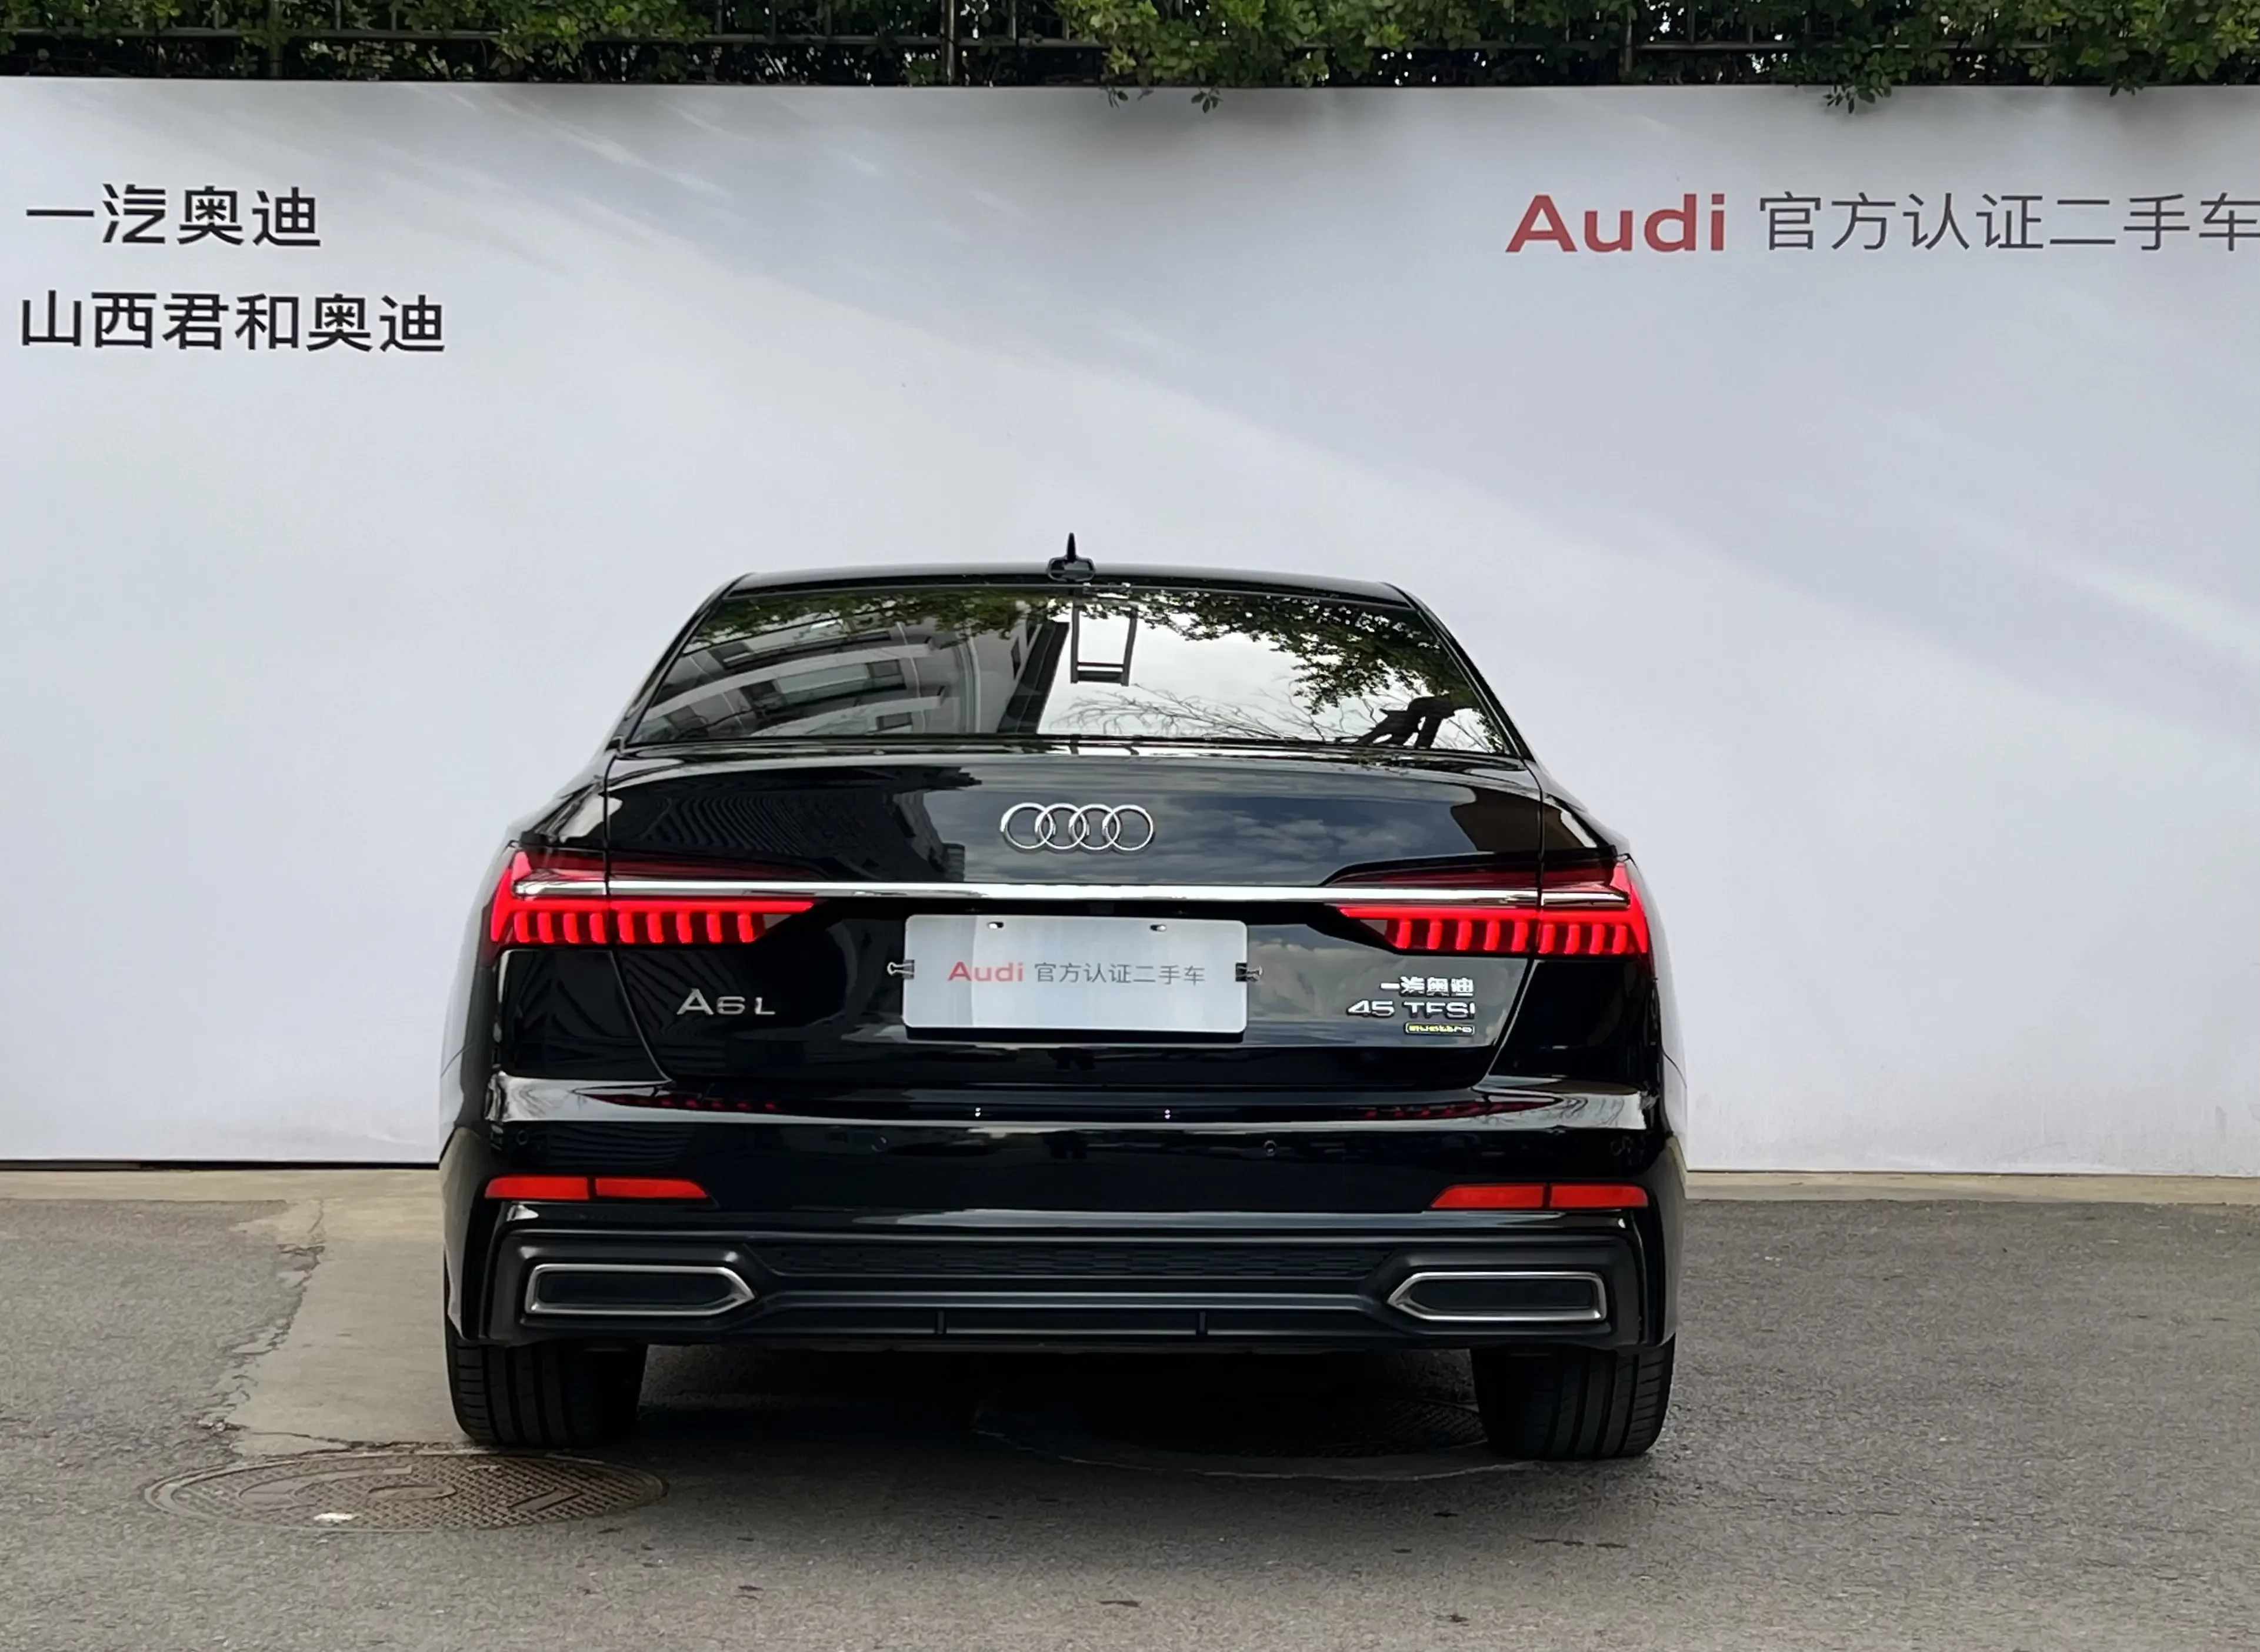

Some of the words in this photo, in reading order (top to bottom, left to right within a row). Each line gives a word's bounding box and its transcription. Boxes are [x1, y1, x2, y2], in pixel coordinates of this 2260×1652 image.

[25, 183, 321, 247] 一汽奥迪
[1505, 193, 1725, 253] Audi
[1759, 191, 2260, 252] 官方认证二手车
[21, 289, 445, 353] 山西君和奥迪
[948, 960, 1024, 983] Audi
[1034, 962, 1206, 986] 官方认证二手车
[1379, 976, 1474, 997] 一汽奥迪
[1347, 1000, 1395, 1017] 45
[1403, 1001, 1476, 1019] TFSI
